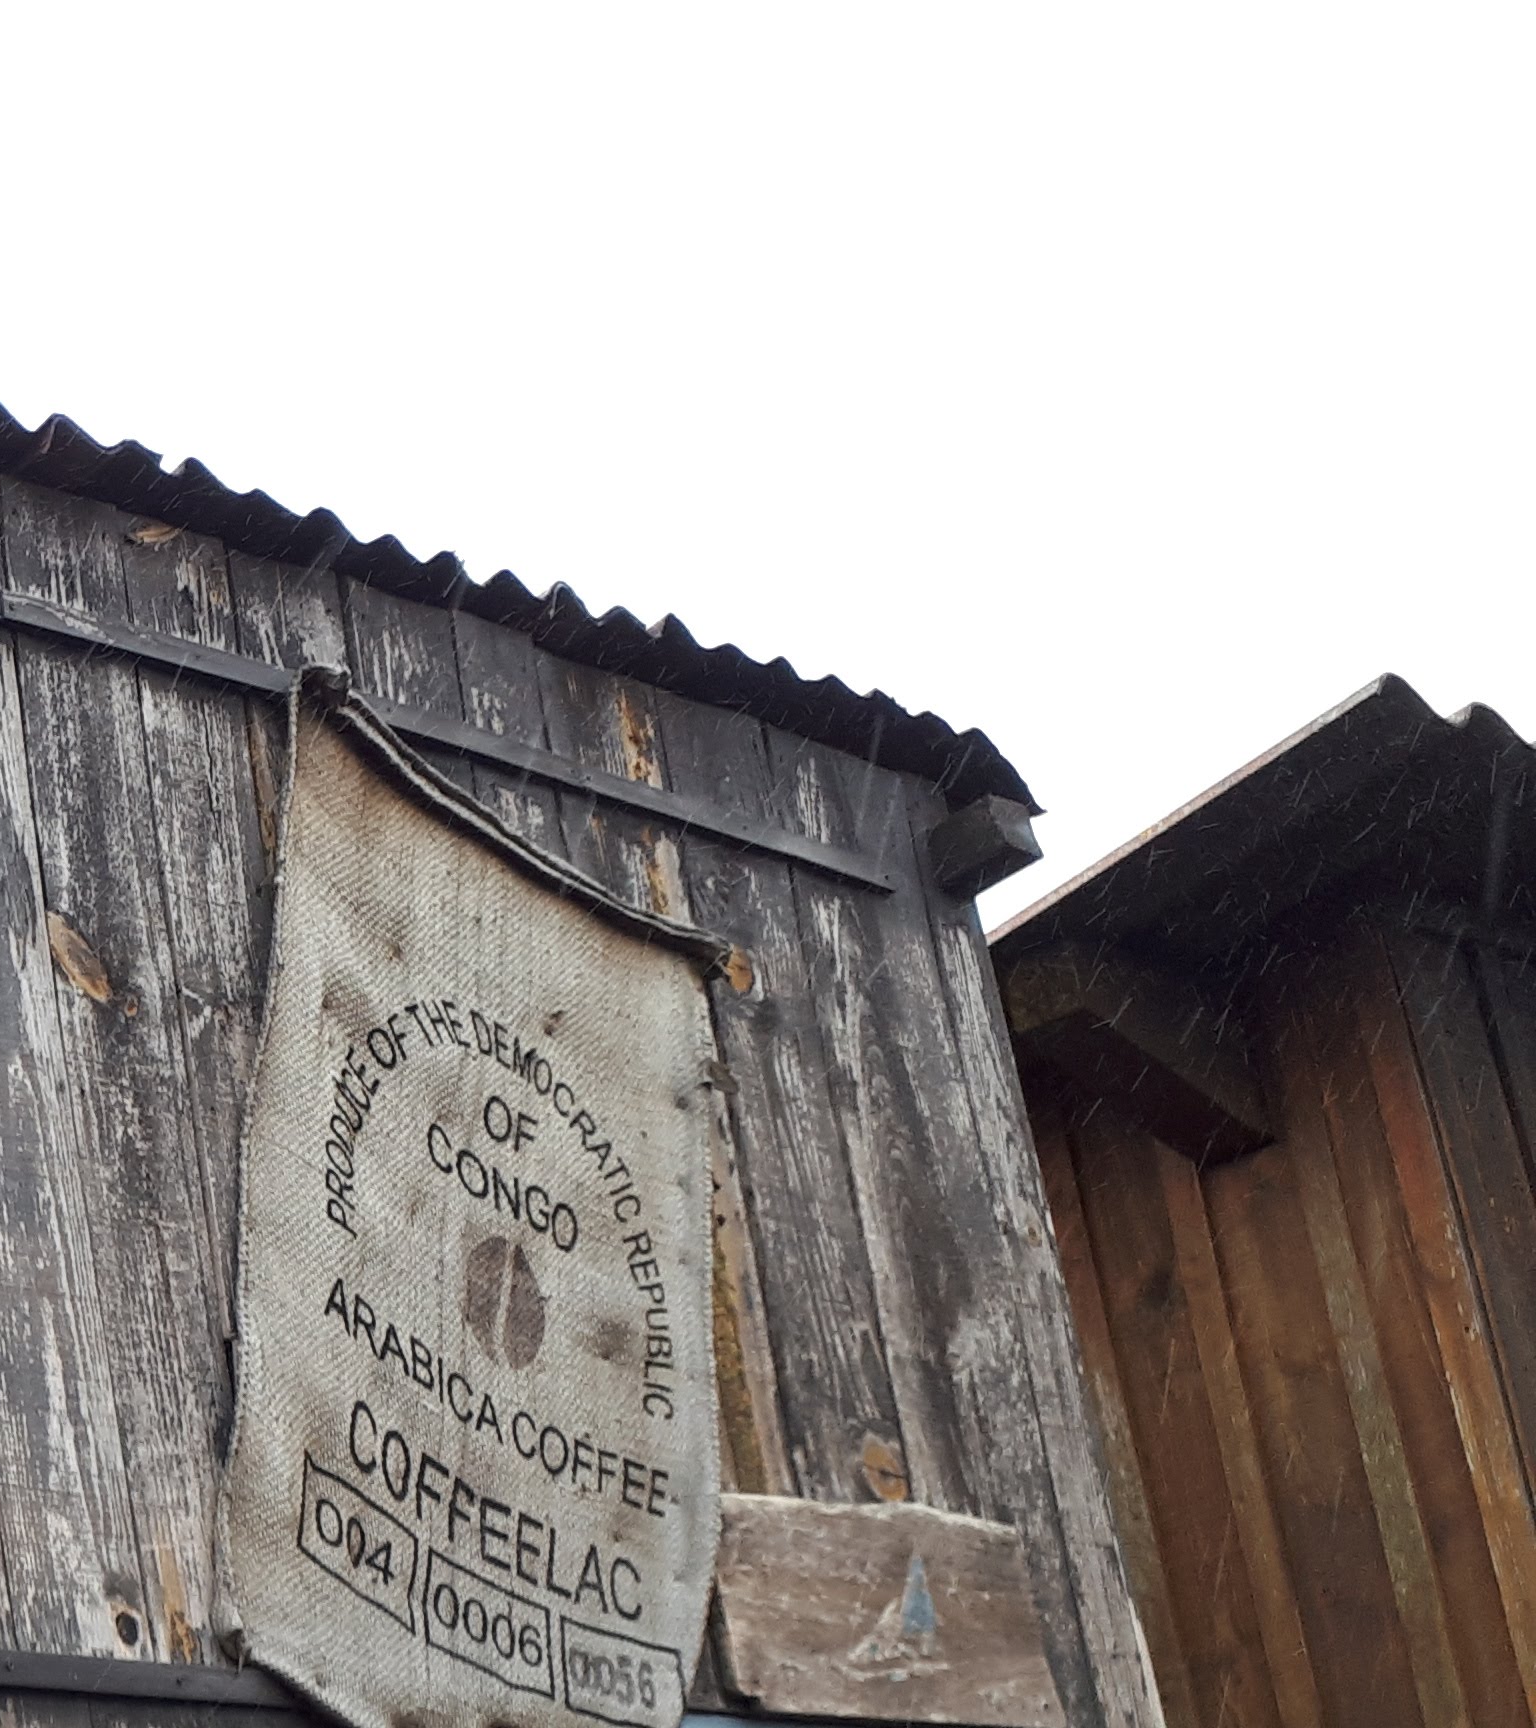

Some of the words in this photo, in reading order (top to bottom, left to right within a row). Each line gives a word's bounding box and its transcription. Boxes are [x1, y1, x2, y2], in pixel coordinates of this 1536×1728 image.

[326, 1047, 380, 1238] PRODUCE
[367, 1014, 407, 1069] OF
[405, 1000, 471, 1049] THE
[471, 1010, 641, 1223] DEMOCRATIC
[623, 1230, 674, 1420] REPUBLIC
[428, 1123, 577, 1252] CONGO
[484, 1096, 538, 1151] OF
[324, 1278, 503, 1445] ARABICA
[512, 1412, 669, 1517] COFFEE
[315, 1499, 395, 1585] 004
[433, 1583, 542, 1666] 0006
[349, 1401, 642, 1621] COFFEELAC
